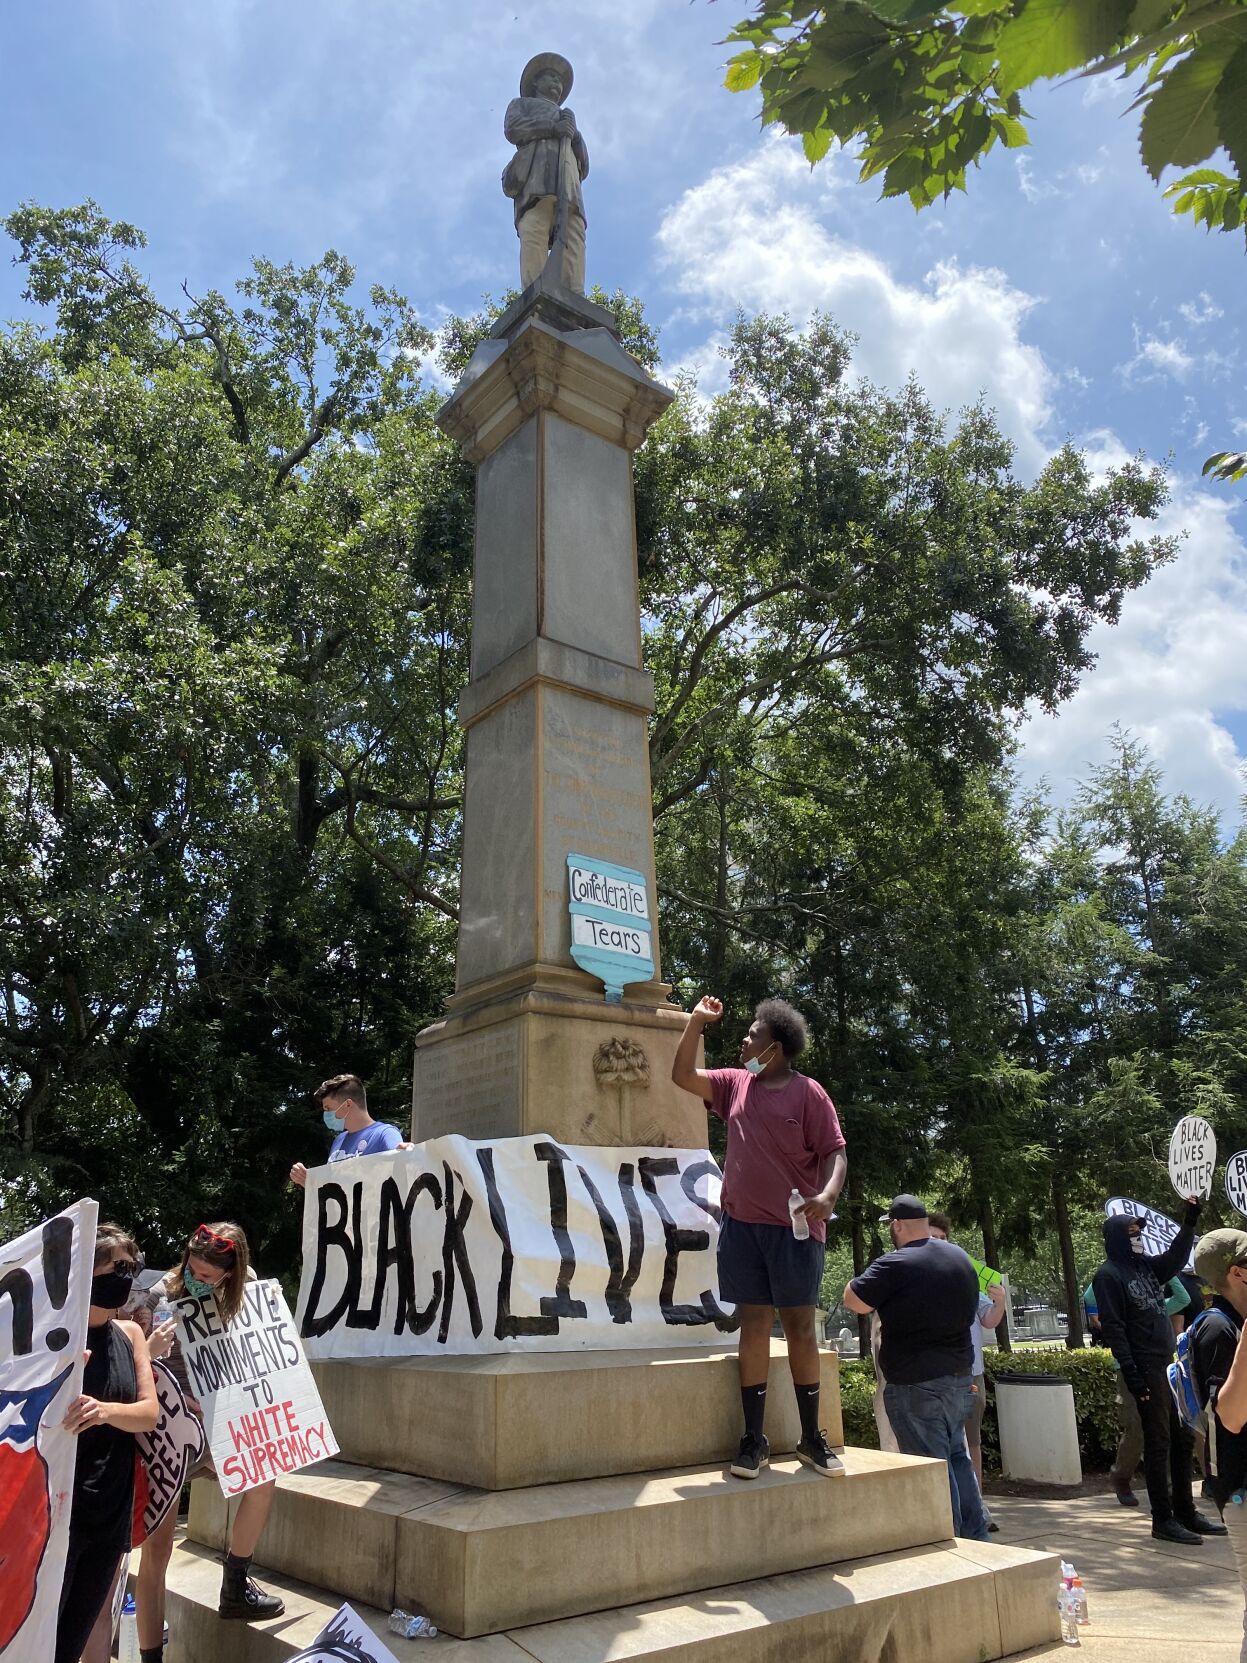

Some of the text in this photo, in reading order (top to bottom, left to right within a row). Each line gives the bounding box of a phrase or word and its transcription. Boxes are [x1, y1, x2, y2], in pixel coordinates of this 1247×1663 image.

[571, 869, 645, 913] Confederate
[585, 919, 641, 954] Tears
[1181, 1120, 1210, 1145] BLACK
[1173, 1144, 1204, 1165] LIVES
[1176, 1161, 1212, 1191] MATTER
[1121, 1199, 1177, 1235] BLACK
[301, 1159, 483, 1344] BLACK
[186, 1322, 300, 1396] MONUMENTS
[242, 1378, 274, 1407] TO
[227, 1400, 300, 1452] WHITE
[223, 1421, 332, 1494] SUPREMACY
